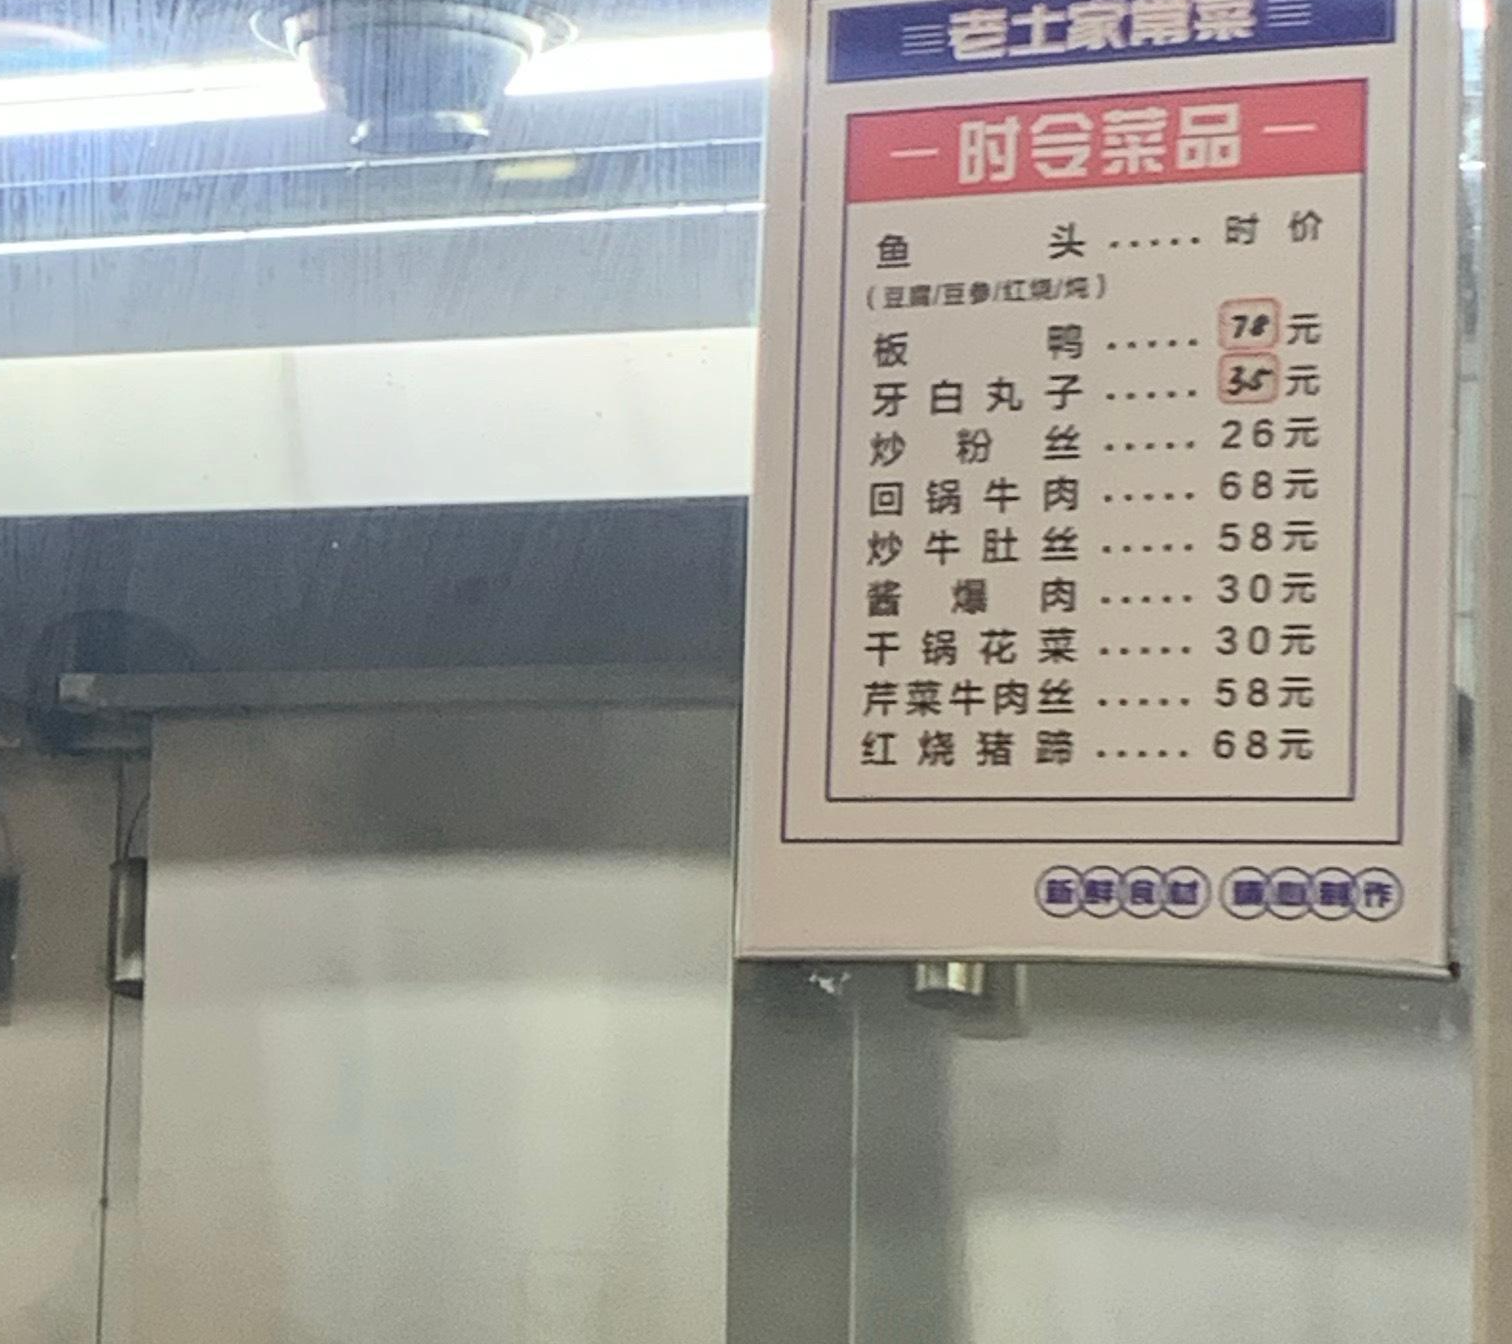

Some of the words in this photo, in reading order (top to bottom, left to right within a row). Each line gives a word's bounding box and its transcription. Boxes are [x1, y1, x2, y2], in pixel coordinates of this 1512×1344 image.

[957, 102, 1244, 184] 时令菜品
[876, 222, 1085, 269] 鱼头
[1225, 210, 1323, 246] 时价
[872, 374, 1083, 416] 牙白丸子
[870, 425, 1081, 467] 炒粉丝
[1220, 417, 1320, 450] 26元
[870, 477, 1080, 516] 回锅牛肉
[1218, 466, 1320, 500] 68元
[866, 527, 1079, 563] 炒牛肚丝
[1218, 519, 1319, 552] 58元
[866, 576, 1078, 615] 酱爆肉
[1216, 571, 1318, 603] 30元
[864, 626, 1078, 667] 干锅花菜
[1215, 624, 1316, 655] 30元
[862, 677, 1075, 716] 芹菜牛肉丝
[1214, 674, 1315, 706] 58元
[860, 728, 1074, 766] 红烧猪蹄
[1212, 725, 1314, 759] 68元
